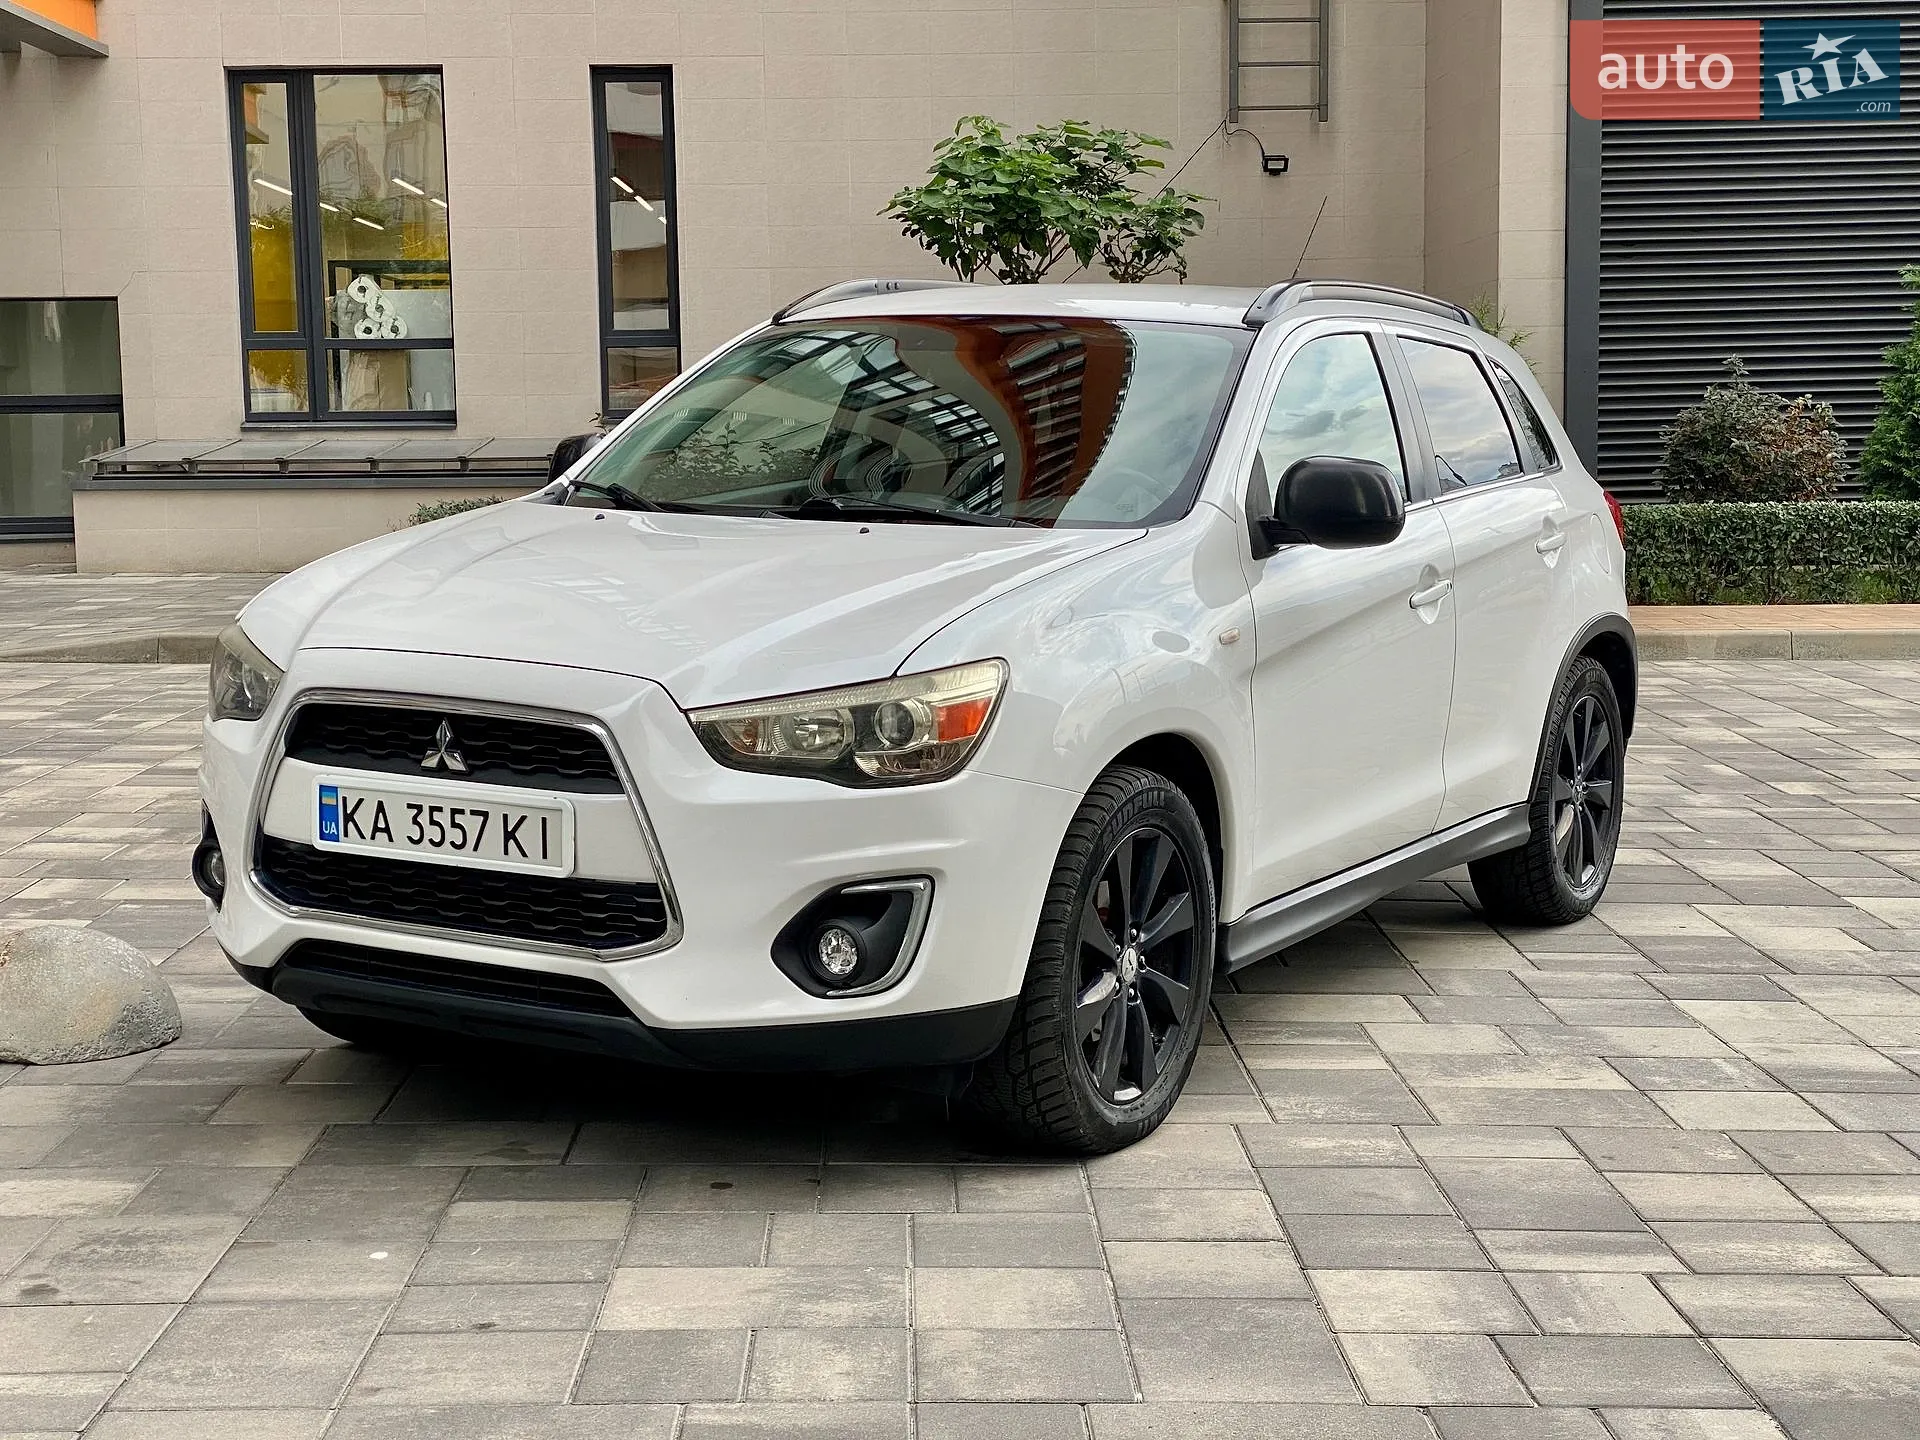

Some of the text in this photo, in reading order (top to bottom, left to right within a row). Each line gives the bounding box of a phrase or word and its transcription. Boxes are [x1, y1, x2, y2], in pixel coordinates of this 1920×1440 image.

[322, 821, 339, 836] UA
[342, 796, 548, 859] KA 3557 KI
